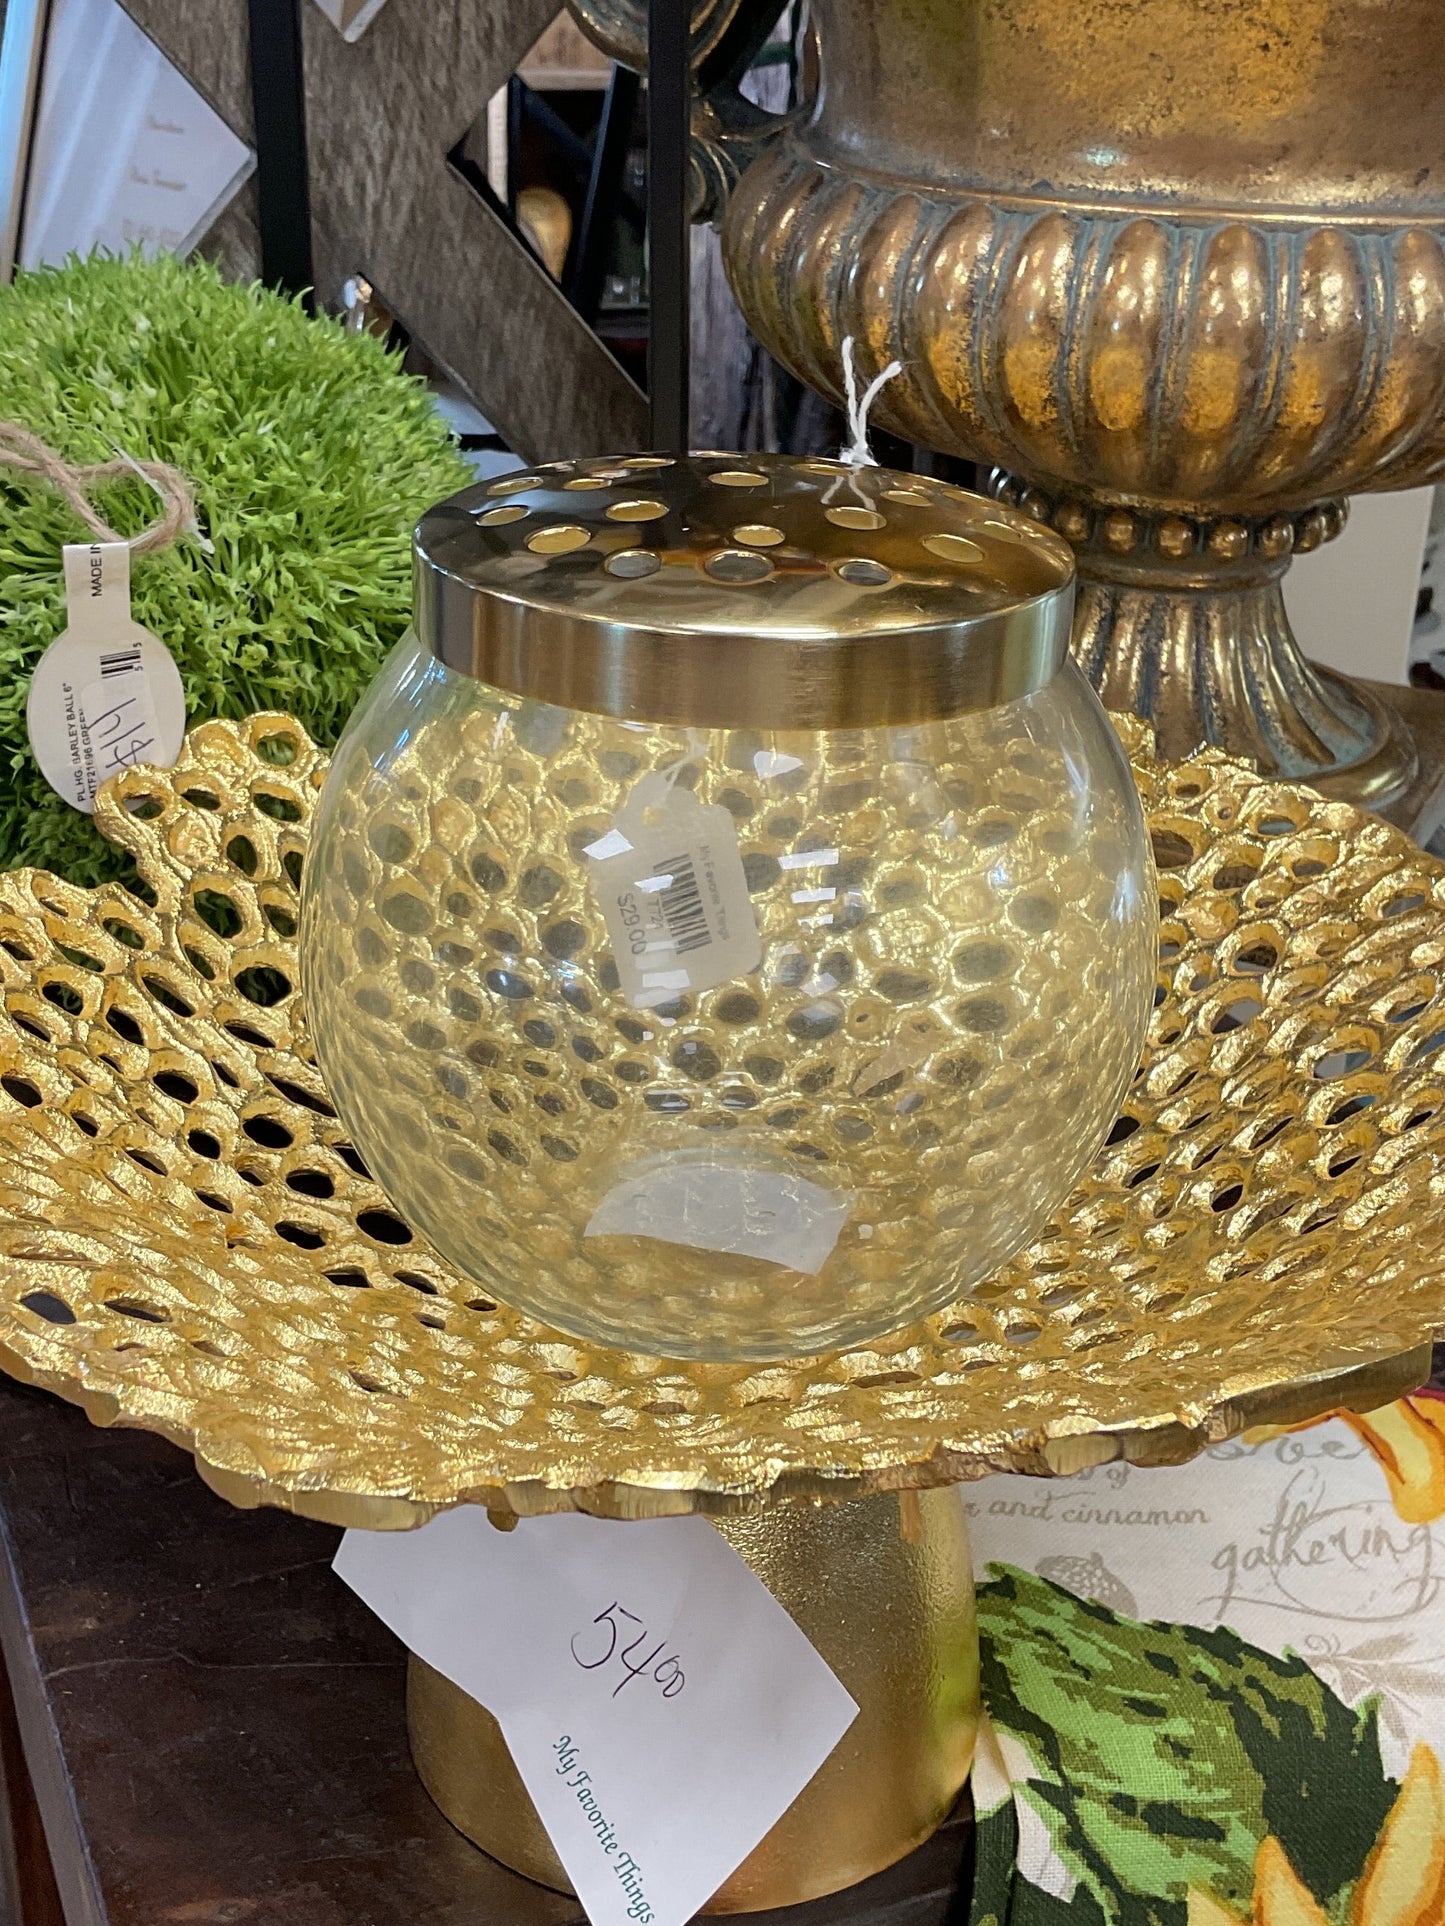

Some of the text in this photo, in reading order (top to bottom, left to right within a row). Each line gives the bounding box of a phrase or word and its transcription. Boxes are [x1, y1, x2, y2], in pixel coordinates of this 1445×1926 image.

[90, 558, 102, 597] MADE
[63, 694, 75, 722] BALL
[66, 723, 81, 765] BARLEY
[988, 1491, 1056, 1521] and
[1062, 1502, 1211, 1526] cinnamon
[1206, 1467, 1440, 1621] gathering
[553, 1735, 656, 1925] My Favorite Things
